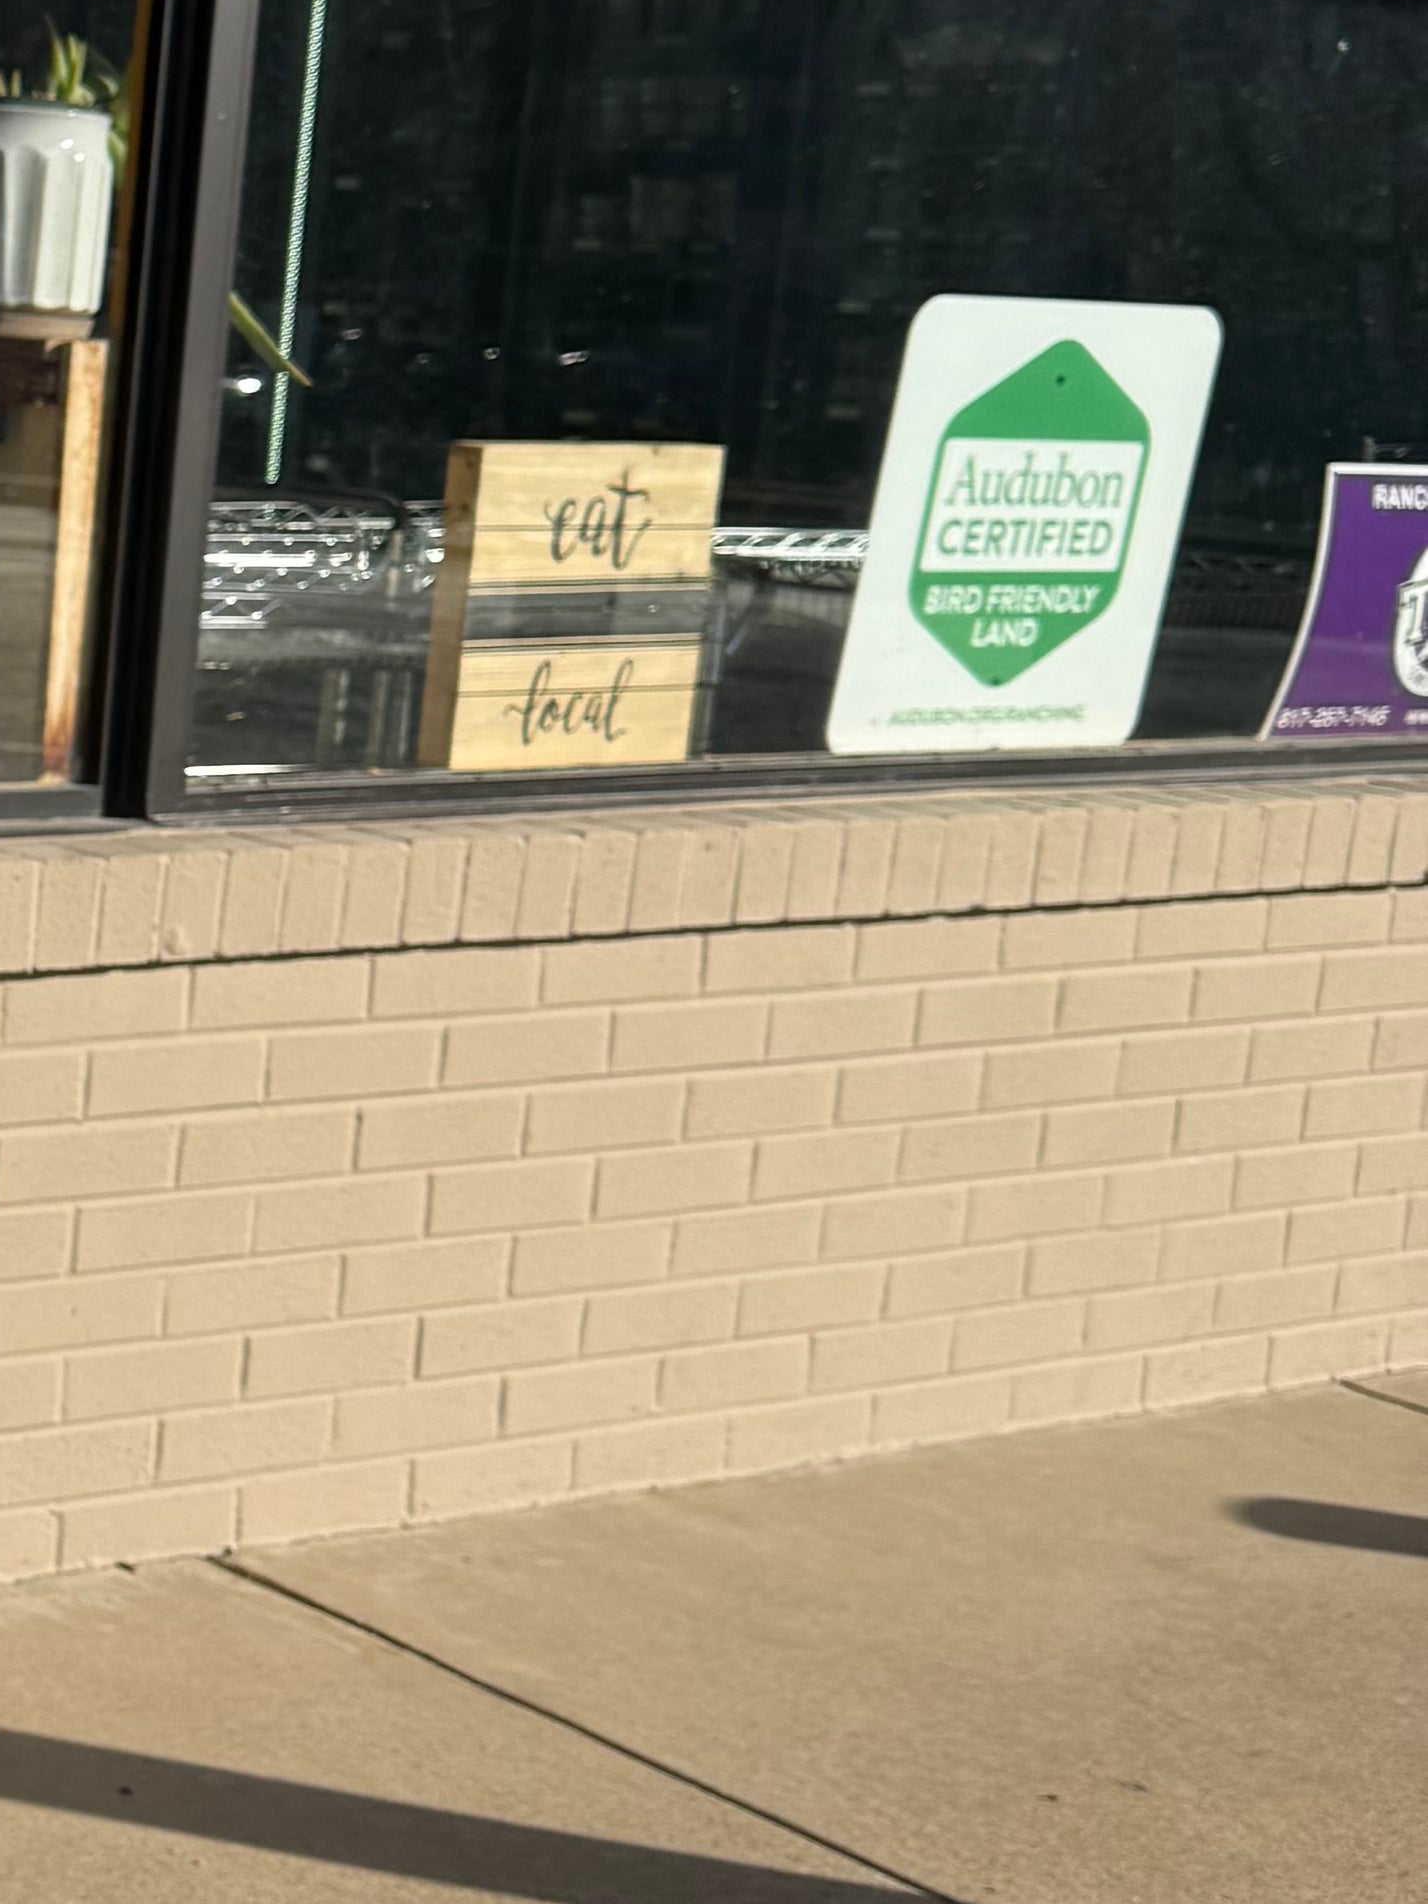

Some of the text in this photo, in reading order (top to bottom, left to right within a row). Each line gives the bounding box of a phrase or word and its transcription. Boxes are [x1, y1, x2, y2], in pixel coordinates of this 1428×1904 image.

[944, 448, 1124, 509] Audubon
[543, 463, 654, 571] eat
[936, 517, 1115, 557] CERTIFIED
[922, 583, 1102, 615] BIRD FRIENDLY
[969, 617, 1040, 648] LAND
[502, 658, 635, 747] local
